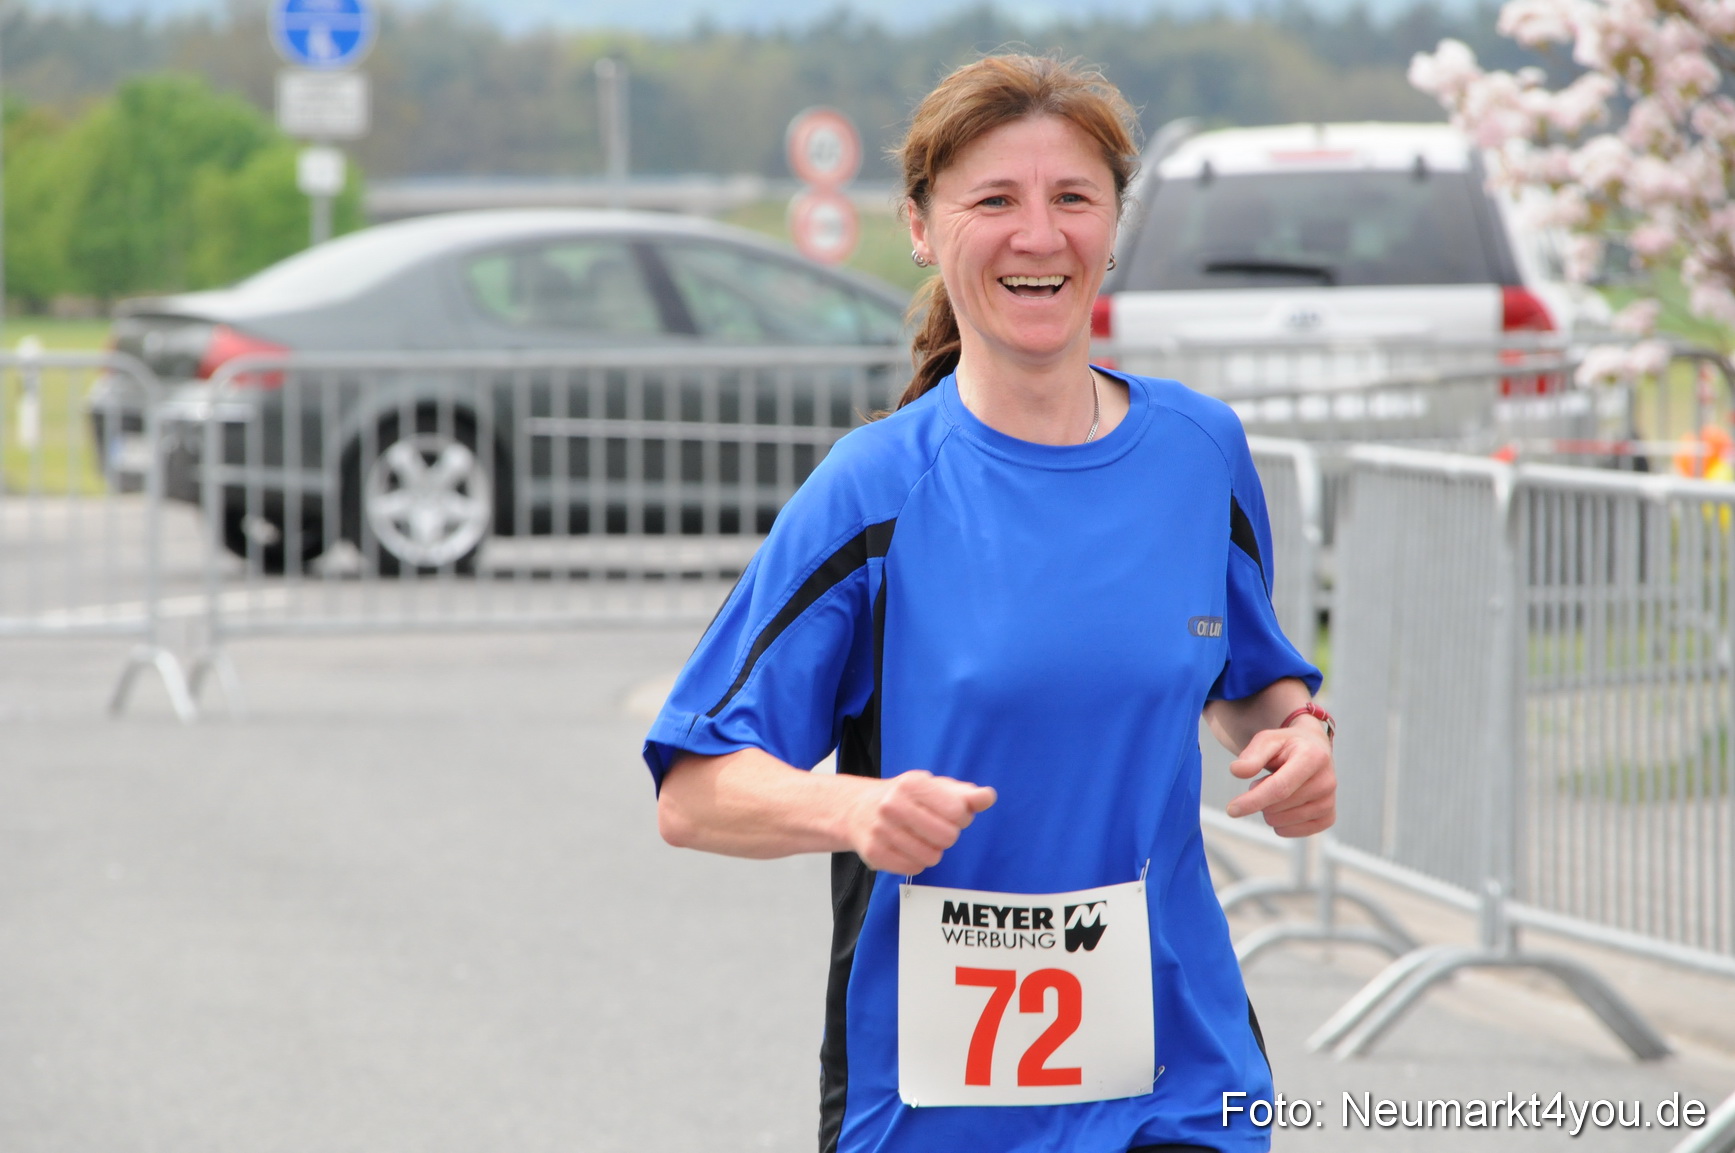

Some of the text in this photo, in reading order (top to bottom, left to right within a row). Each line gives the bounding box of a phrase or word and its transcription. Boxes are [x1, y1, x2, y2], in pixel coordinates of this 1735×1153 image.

[941, 900, 1055, 931] MEYER
[941, 926, 1056, 950] WERBUNG
[955, 966, 1082, 1087] 72
